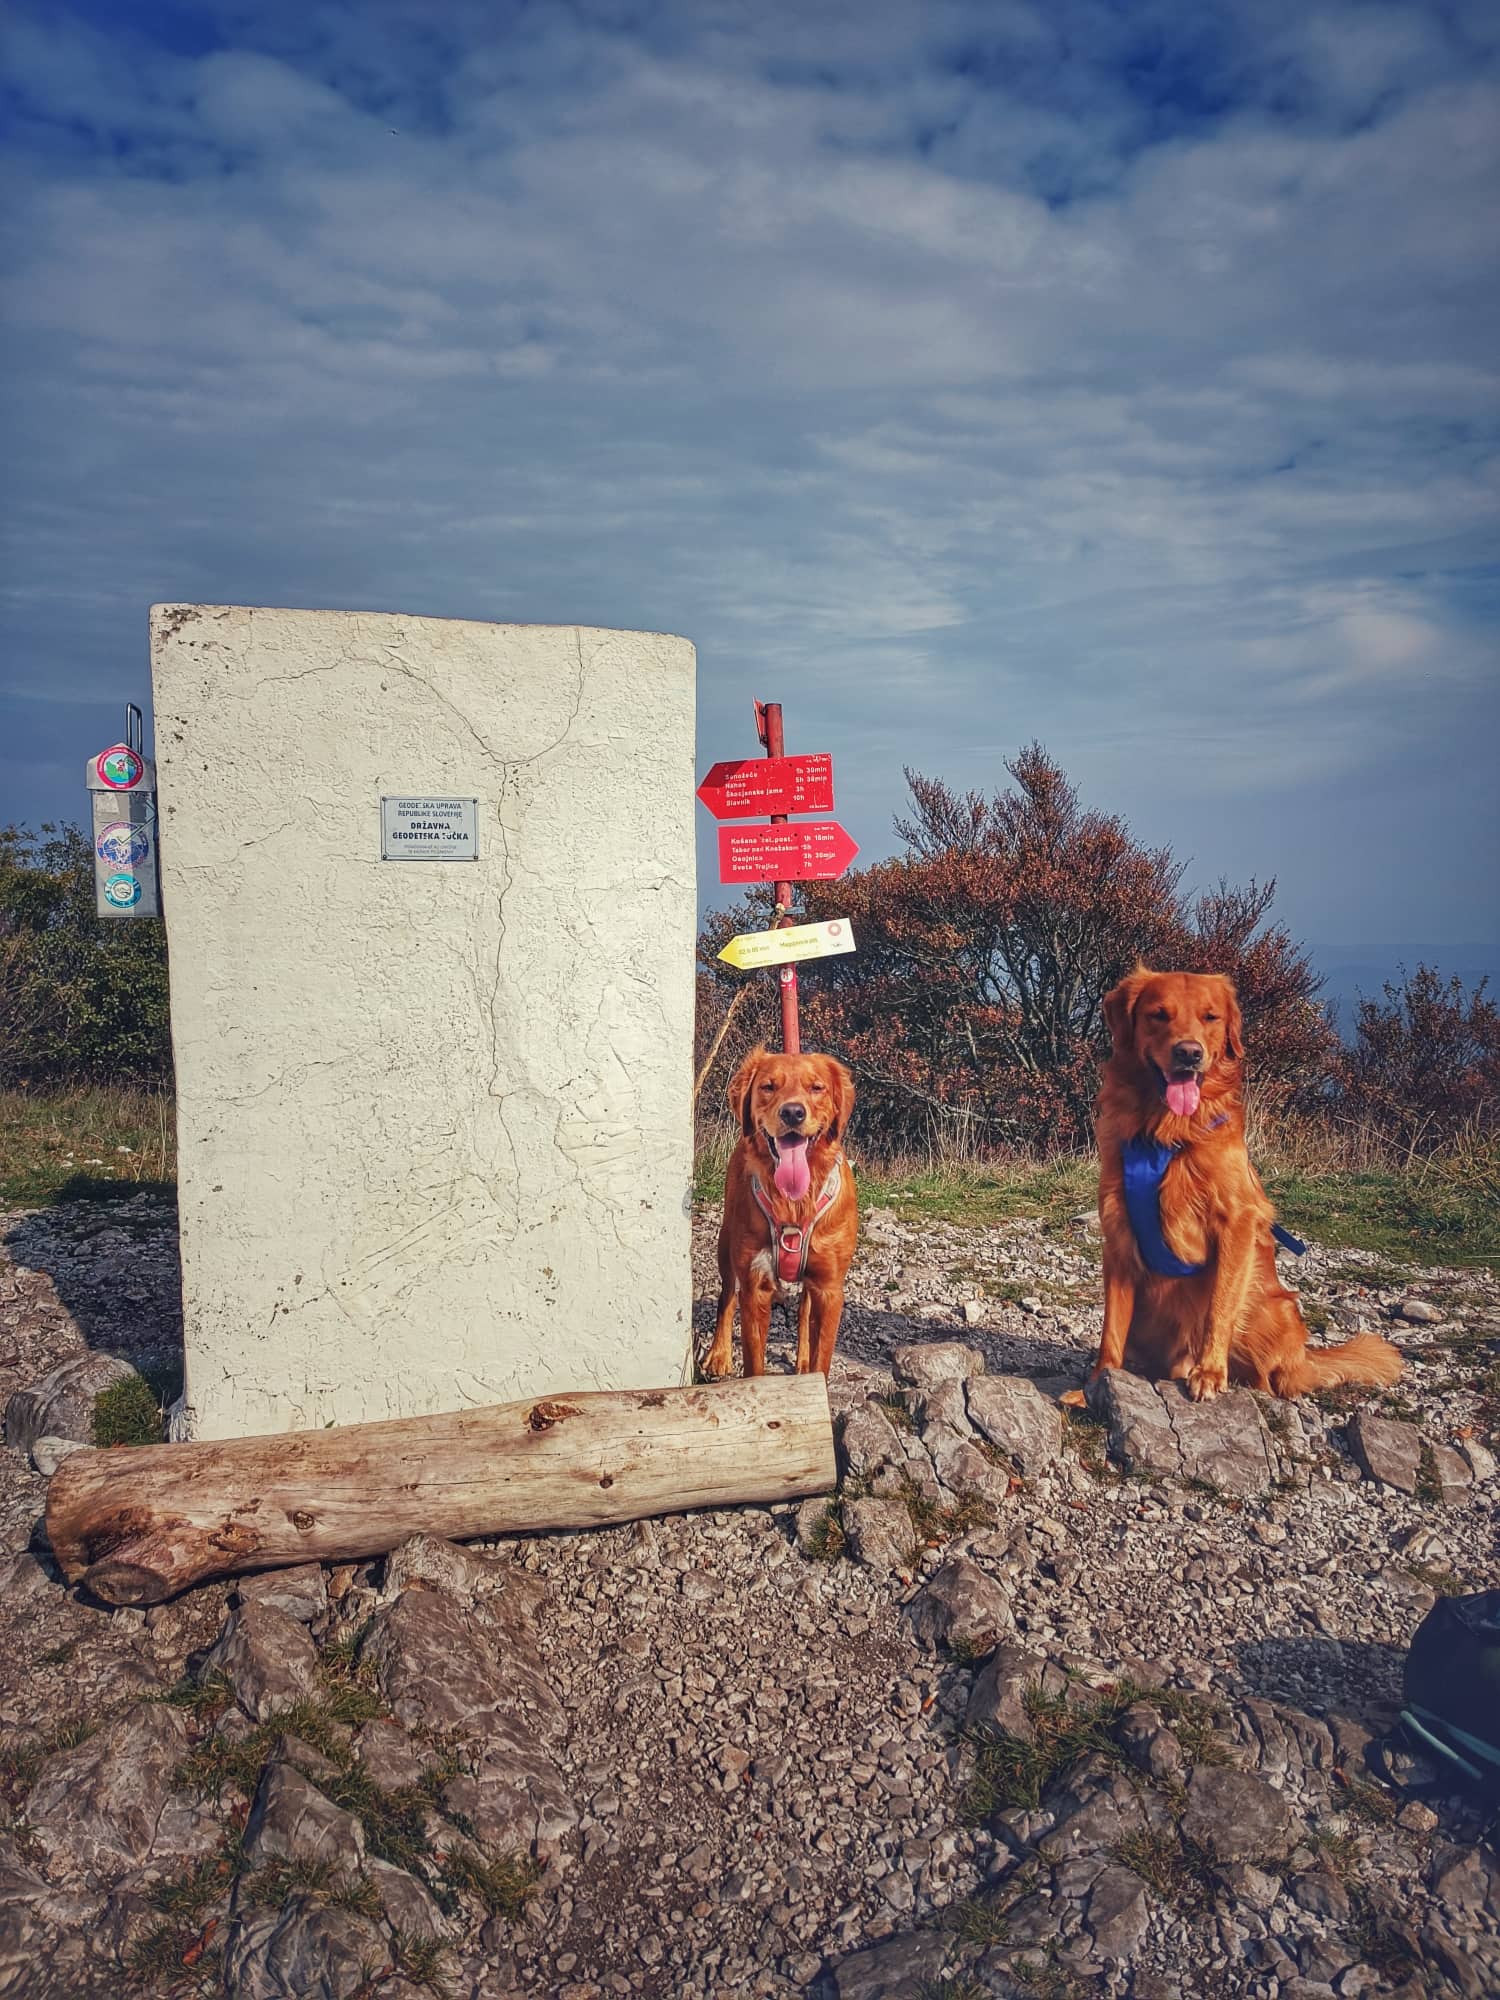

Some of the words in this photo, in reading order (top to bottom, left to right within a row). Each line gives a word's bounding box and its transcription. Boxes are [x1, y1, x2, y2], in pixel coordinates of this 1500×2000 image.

[766, 787, 783, 796] jame
[726, 798, 751, 807] Slavnik
[410, 821, 451, 830] DRŽAVNA
[392, 831, 440, 840] GEODETSKA
